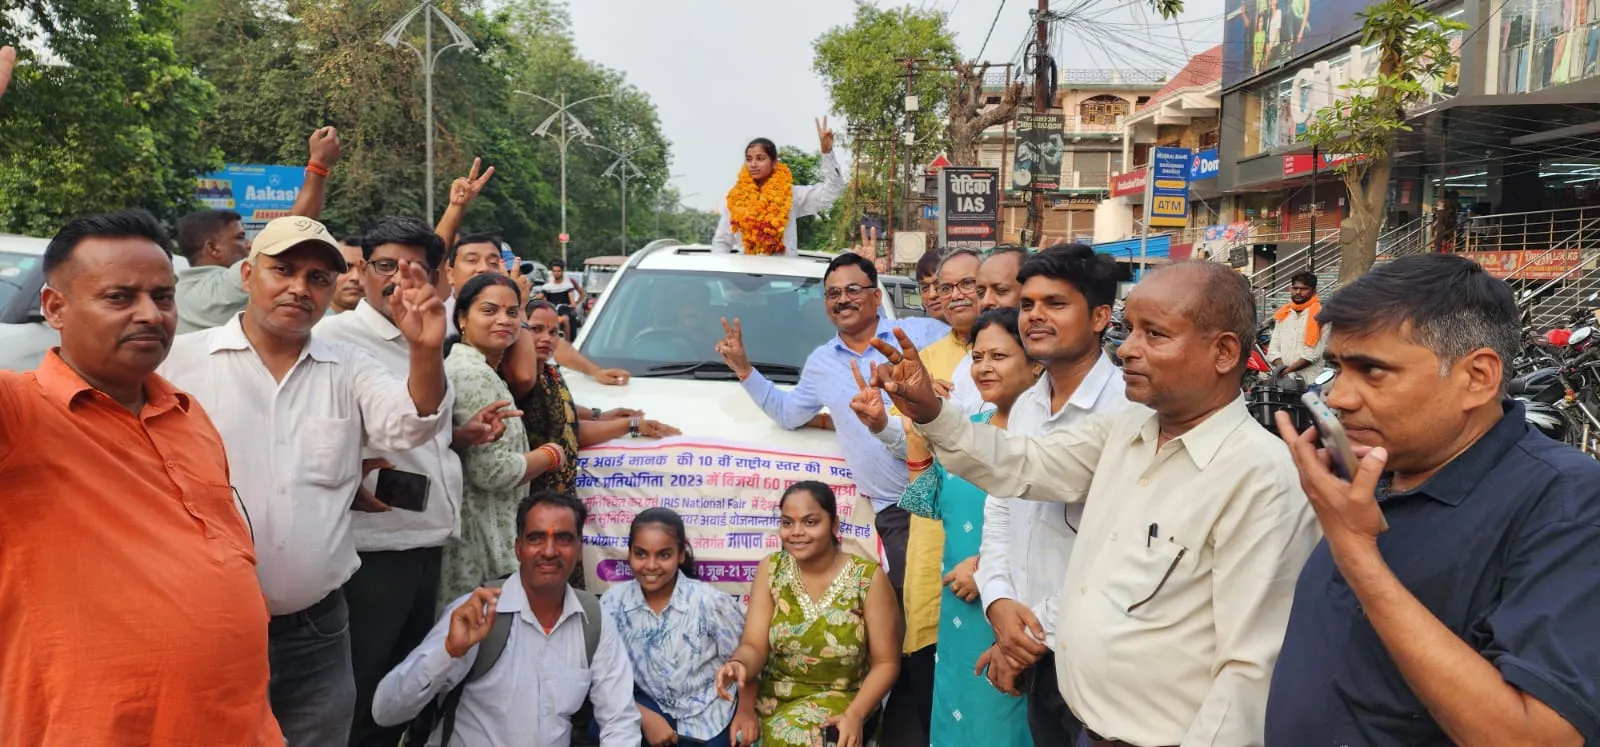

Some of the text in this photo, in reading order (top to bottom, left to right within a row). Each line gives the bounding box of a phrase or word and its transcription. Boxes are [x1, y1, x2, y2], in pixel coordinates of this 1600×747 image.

[950, 174, 991, 195] वेदिका
[957, 197, 985, 212] IAS
[1158, 200, 1181, 211] ATM
[592, 453, 625, 467] अवार्ड
[629, 455, 668, 466] मानक
[677, 452, 694, 466] की
[699, 456, 713, 467] 10
[735, 457, 772, 470] राष्ट्रीय
[776, 459, 800, 472] स्तर
[804, 461, 821, 475] की
[603, 471, 664, 488] प्रतियोगिता
[670, 474, 703, 487] 2023
[706, 471, 720, 487] में
[721, 472, 761, 489] विजयी
[764, 478, 780, 490] 60
[660, 497, 680, 508] IRIS
[682, 497, 725, 509] National
[727, 497, 747, 509] Fair
[700, 511, 727, 527] अवार्ड
[854, 522, 871, 539] हाई
[726, 532, 764, 550] जापान
[765, 535, 779, 549] की
